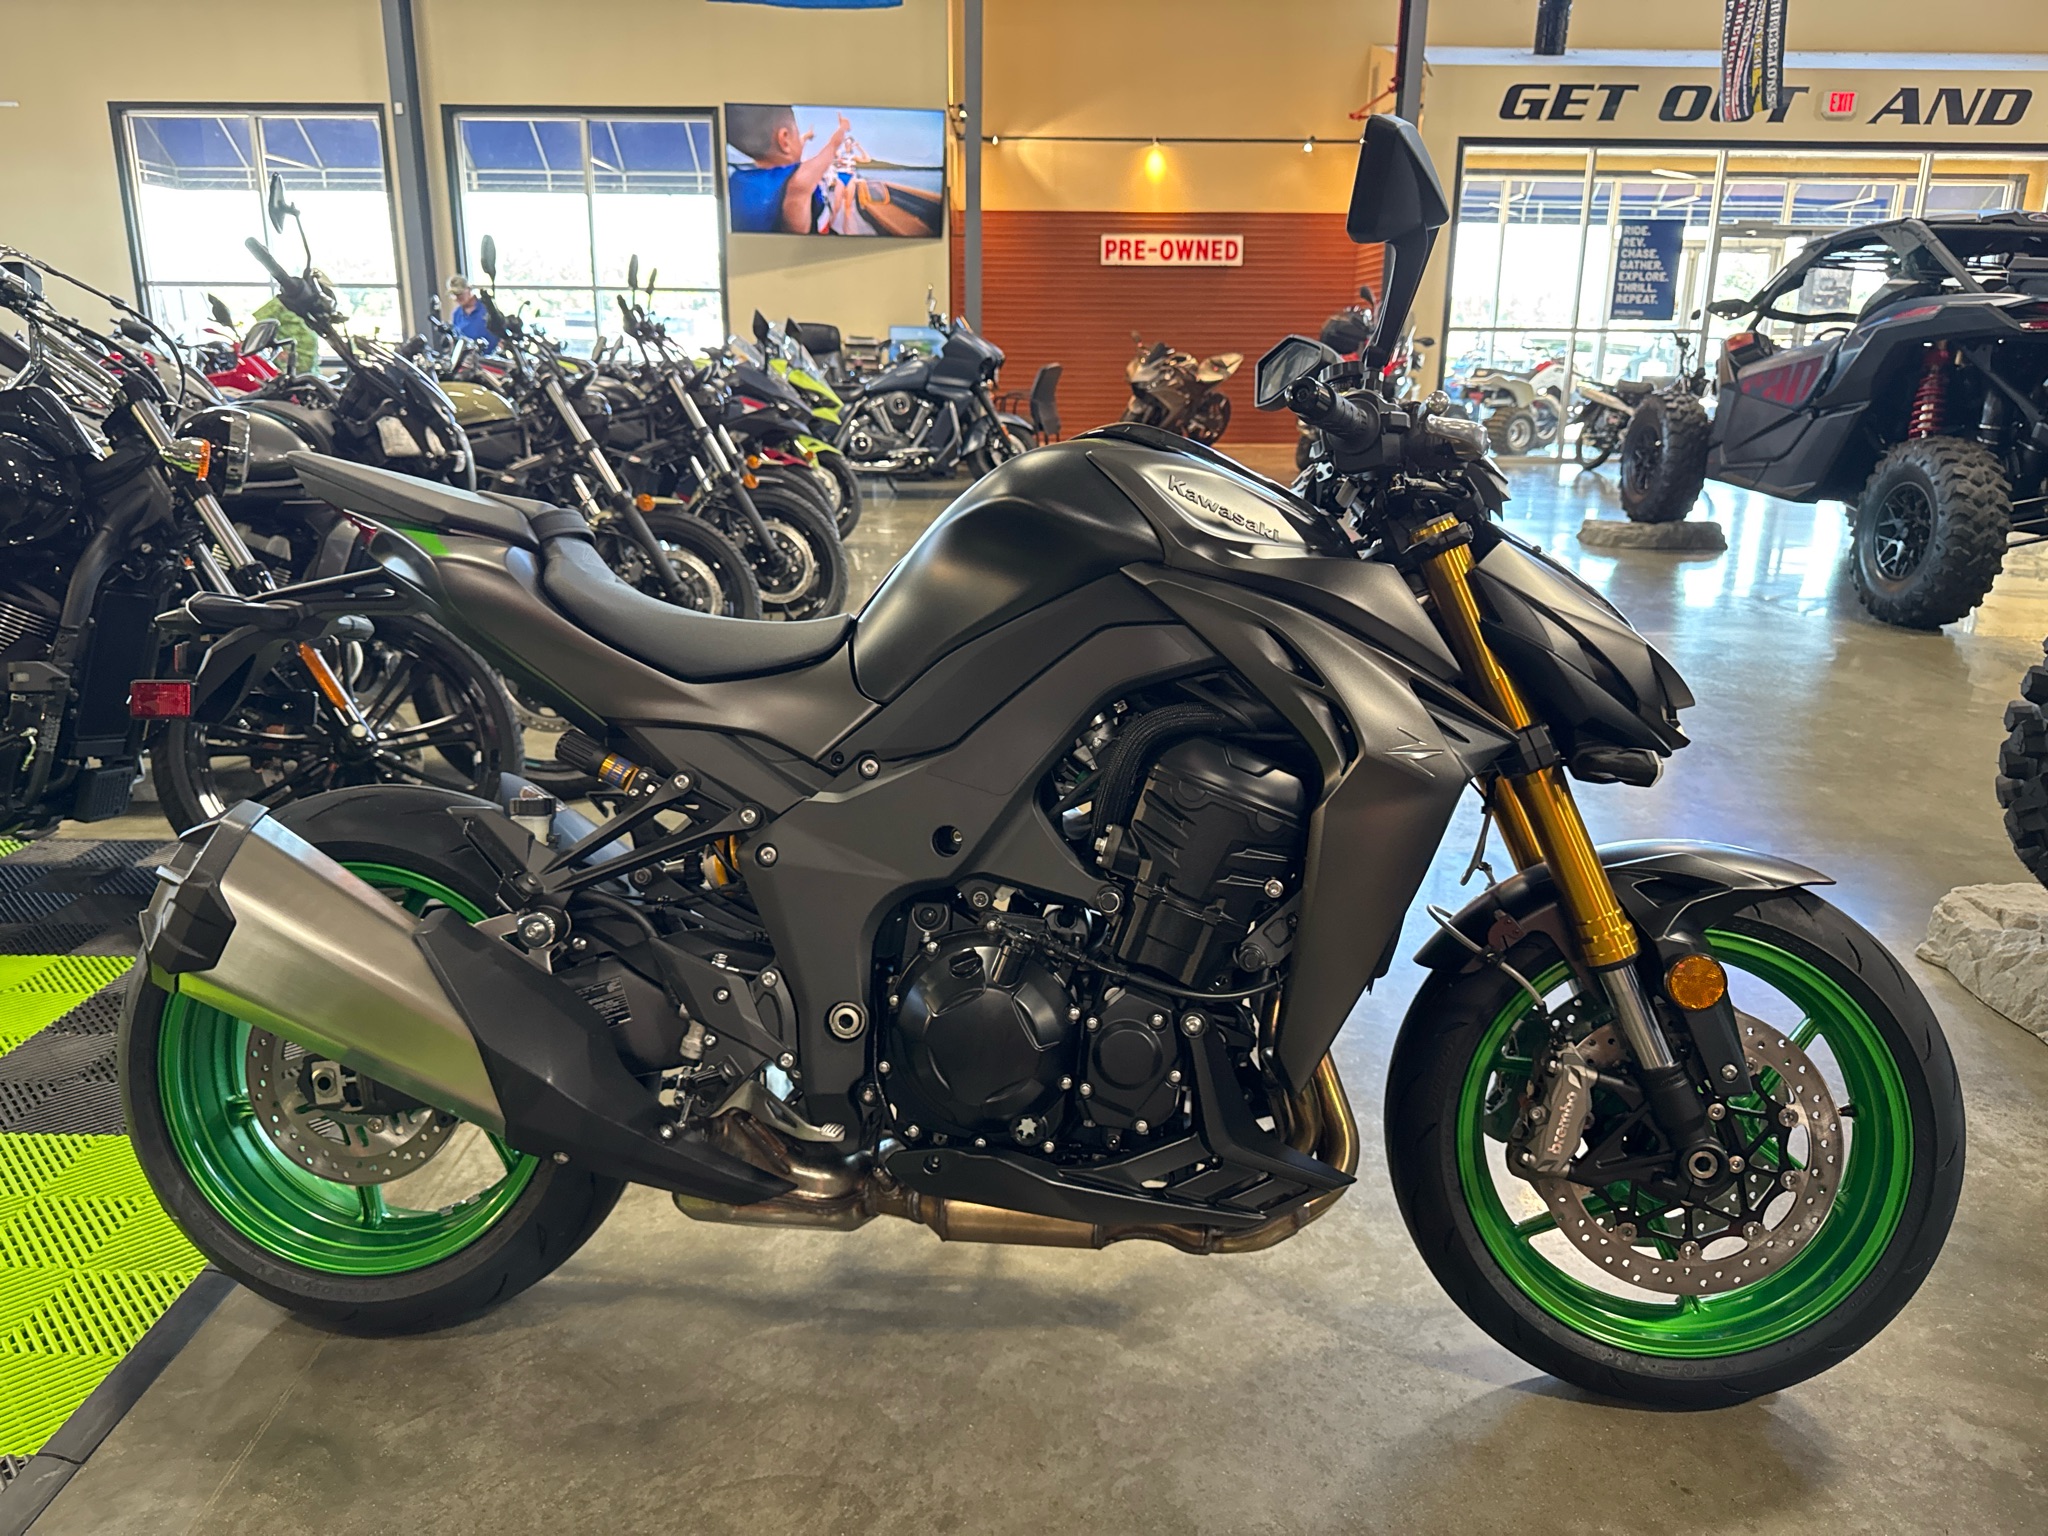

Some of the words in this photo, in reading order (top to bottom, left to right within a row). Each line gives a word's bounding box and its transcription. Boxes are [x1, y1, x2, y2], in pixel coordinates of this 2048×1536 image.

[1766, 0, 1781, 105] RRECTIONS
[1498, 83, 1640, 122] GET
[1866, 87, 2034, 126] AND
[1829, 92, 1855, 113] EXIT
[1623, 225, 1652, 236] RIDE.
[1622, 237, 1647, 248] REV.
[1105, 239, 1239, 261] PRE-OWNED
[1620, 248, 1659, 259] CHASE.
[1619, 260, 1664, 271] GATHER.
[1618, 271, 1669, 282] EXPLORE.
[1617, 282, 1657, 293] THRILL.
[1615, 294, 1659, 305] REPEAT.
[1167, 474, 1280, 543] Kawasaki
[1548, 1091, 1576, 1154] brembo
